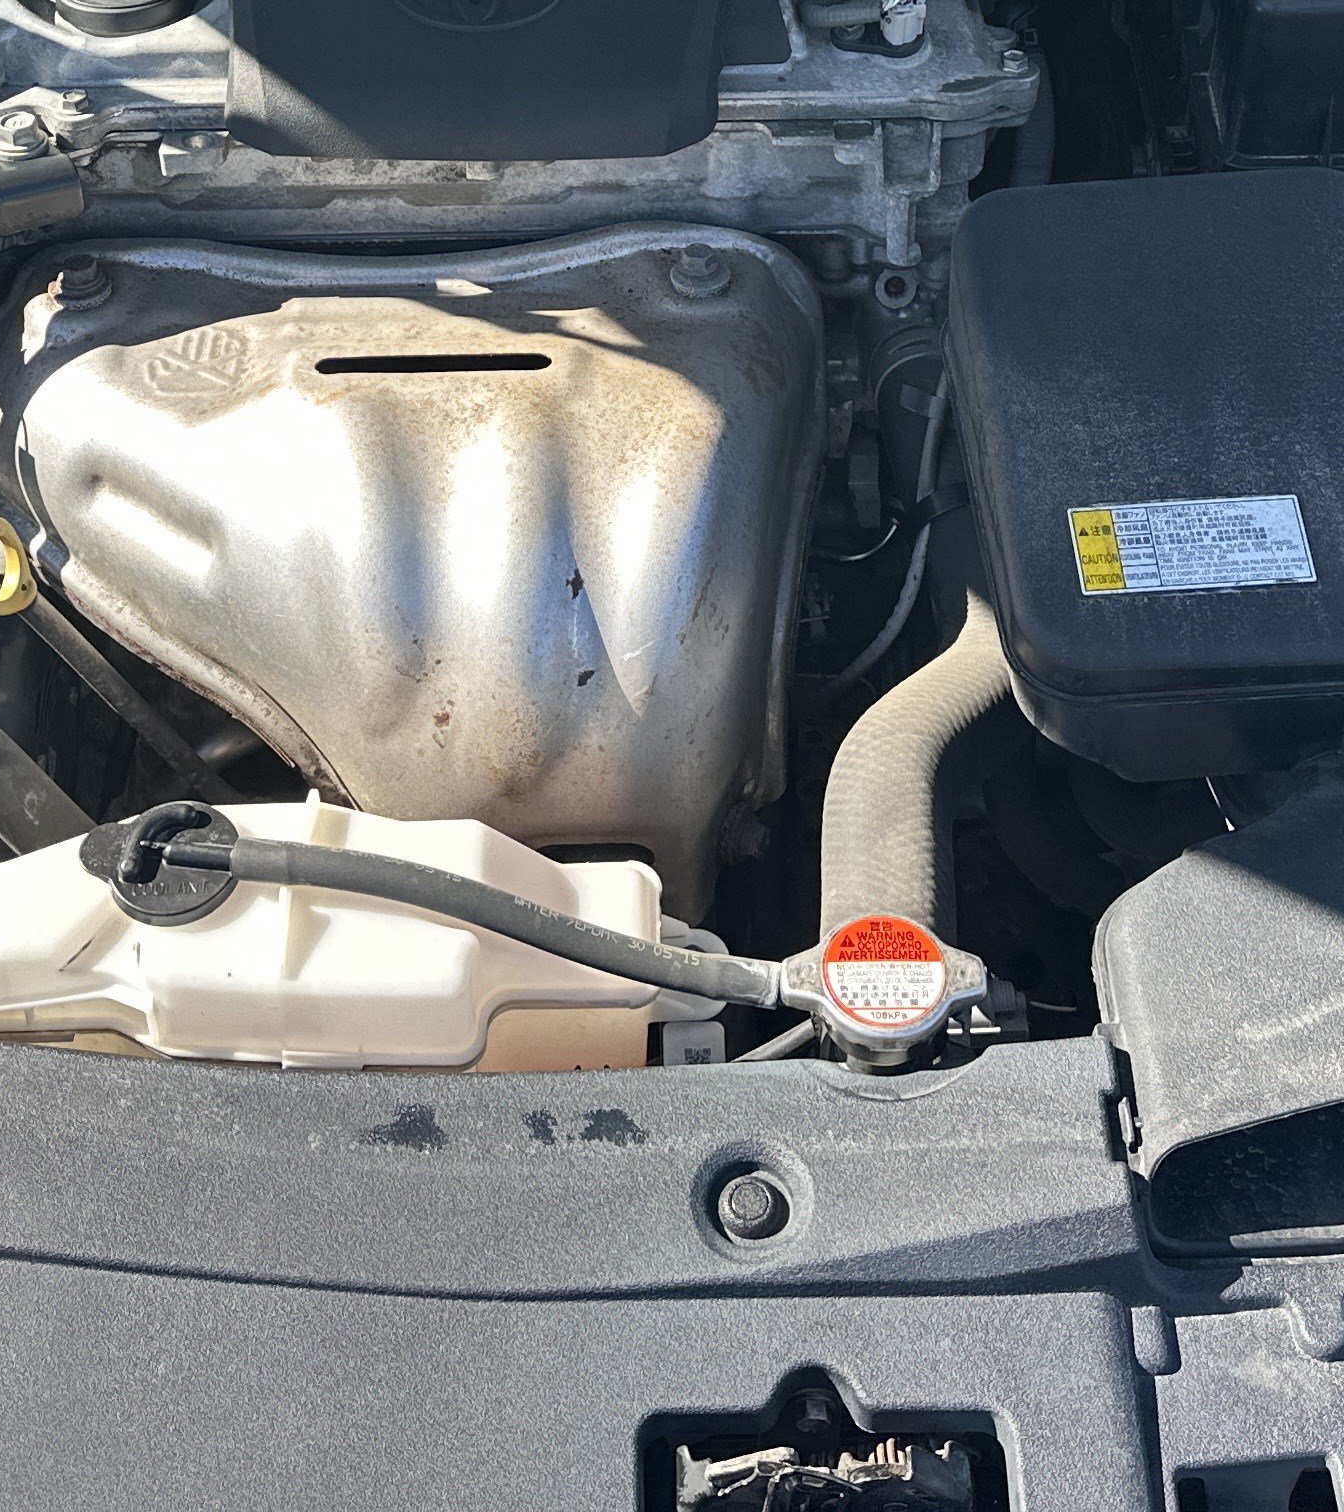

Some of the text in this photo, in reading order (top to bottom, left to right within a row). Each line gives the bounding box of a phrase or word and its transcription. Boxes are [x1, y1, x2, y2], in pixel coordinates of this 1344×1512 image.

[1081, 552, 1118, 565] CAUTION
[1086, 573, 1123, 585] ATTENTION
[131, 877, 208, 897] COOLANT
[514, 895, 558, 921] WATER
[628, 939, 646, 952] 30
[653, 946, 673, 960] 05
[682, 952, 701, 966] 15
[856, 931, 915, 941] WARNING
[857, 941, 922, 951] ОСТОРОЖНО
[838, 950, 930, 961] AVERTISSEMENT
